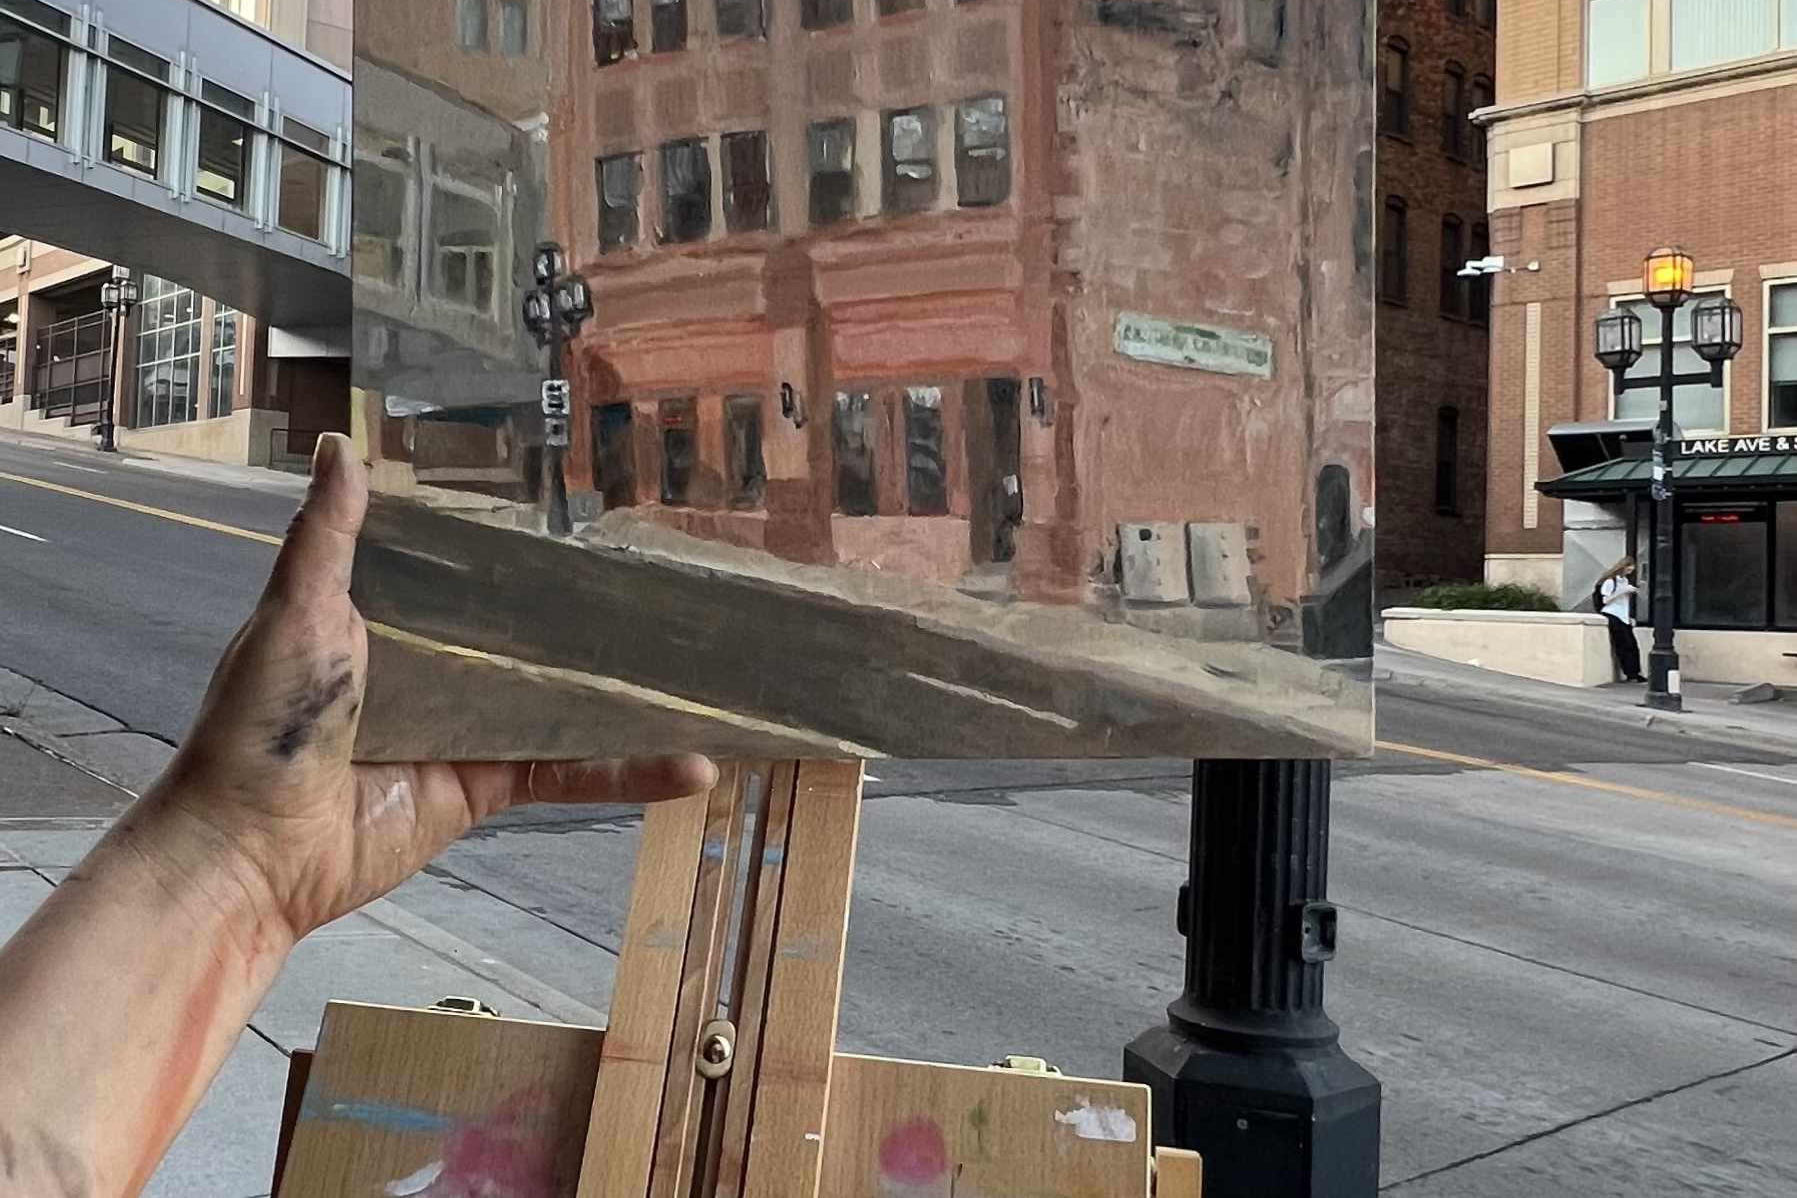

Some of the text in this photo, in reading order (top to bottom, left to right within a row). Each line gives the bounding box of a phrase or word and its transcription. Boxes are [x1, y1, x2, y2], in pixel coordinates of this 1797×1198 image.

[1681, 439, 1730, 455] LAKE
[1734, 437, 1771, 452] AVE
[1776, 437, 1790, 451] &
